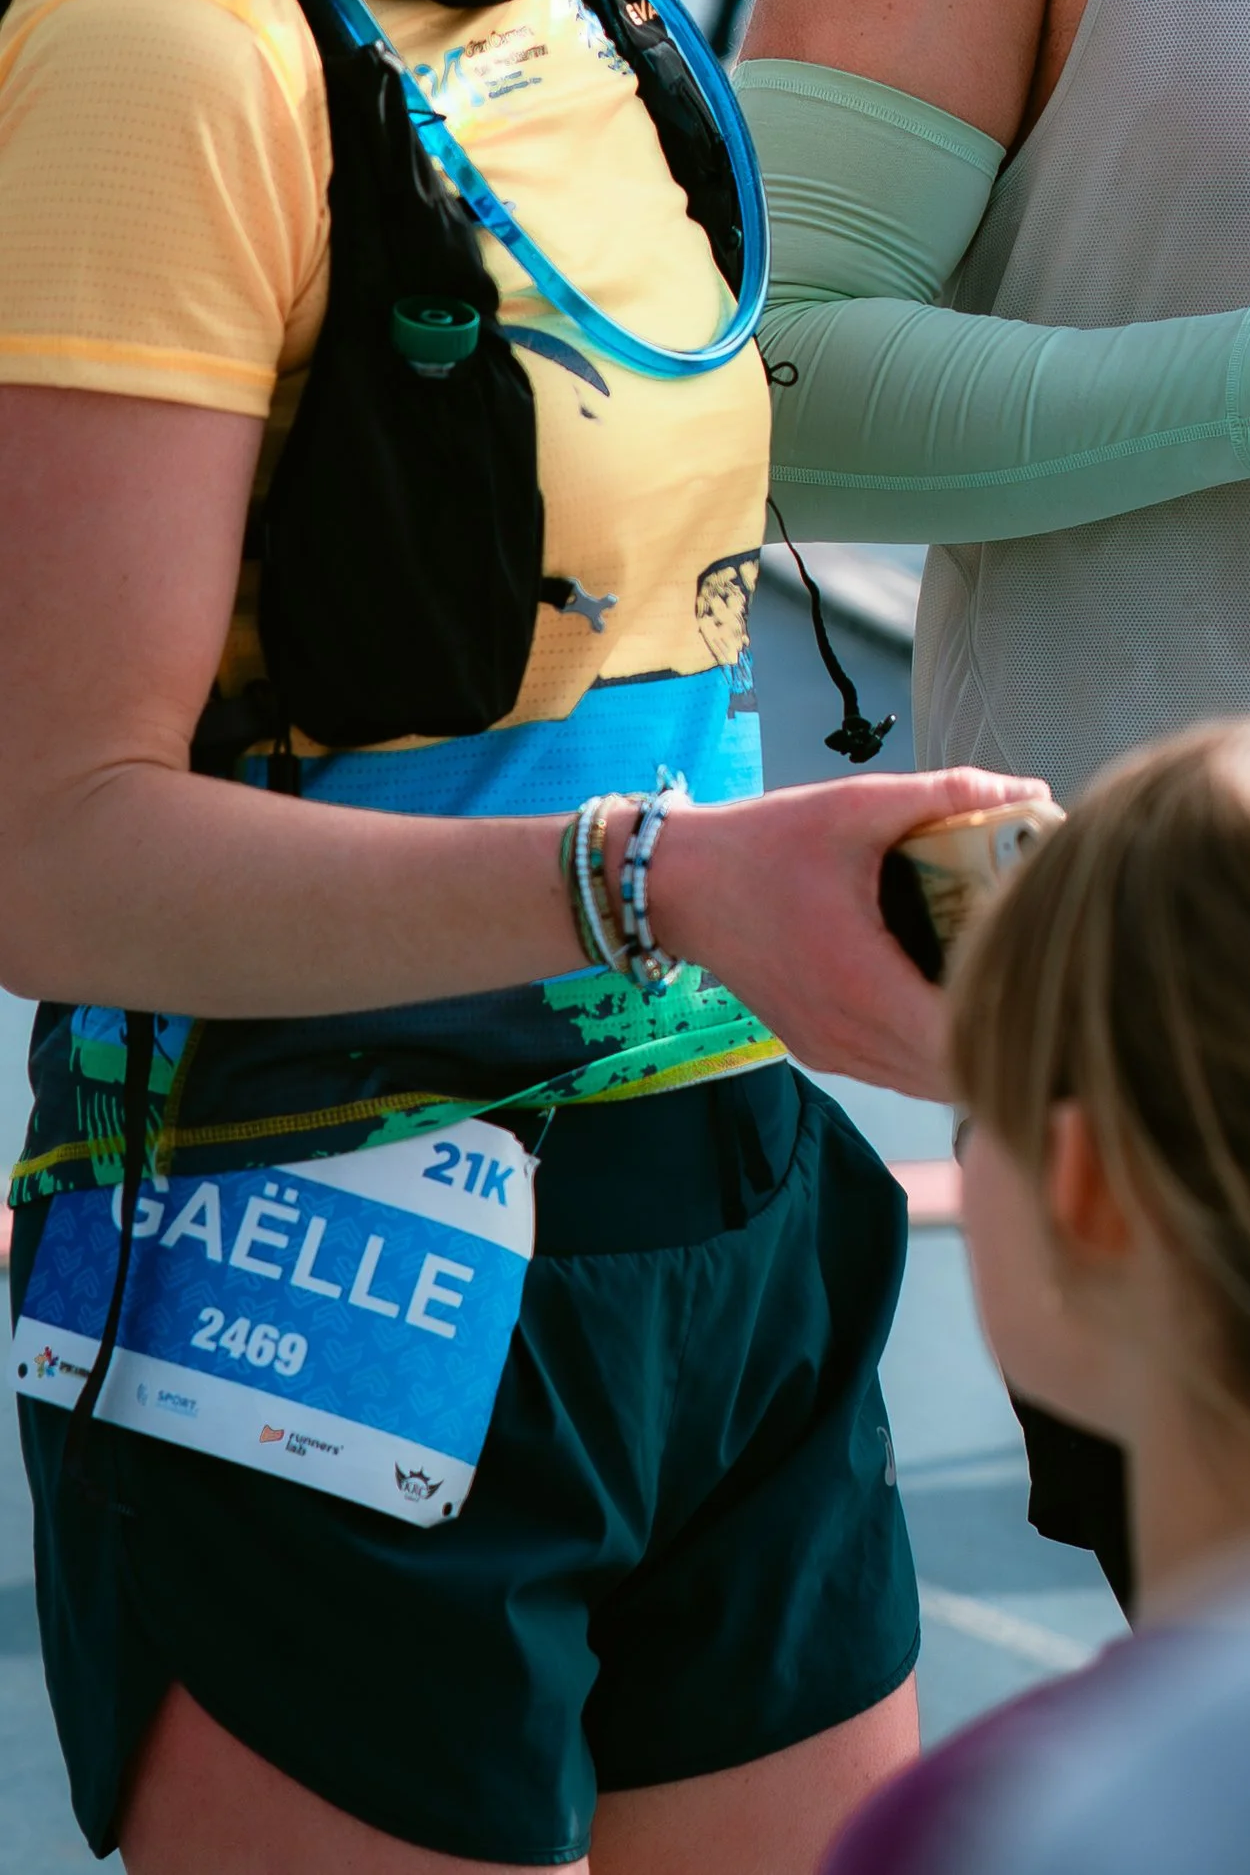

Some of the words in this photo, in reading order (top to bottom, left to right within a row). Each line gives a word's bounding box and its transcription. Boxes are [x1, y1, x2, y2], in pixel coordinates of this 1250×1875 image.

[423, 1142, 515, 1207] 21K
[112, 1175, 476, 1339] GAËLLE
[191, 1307, 308, 1376] 2469
